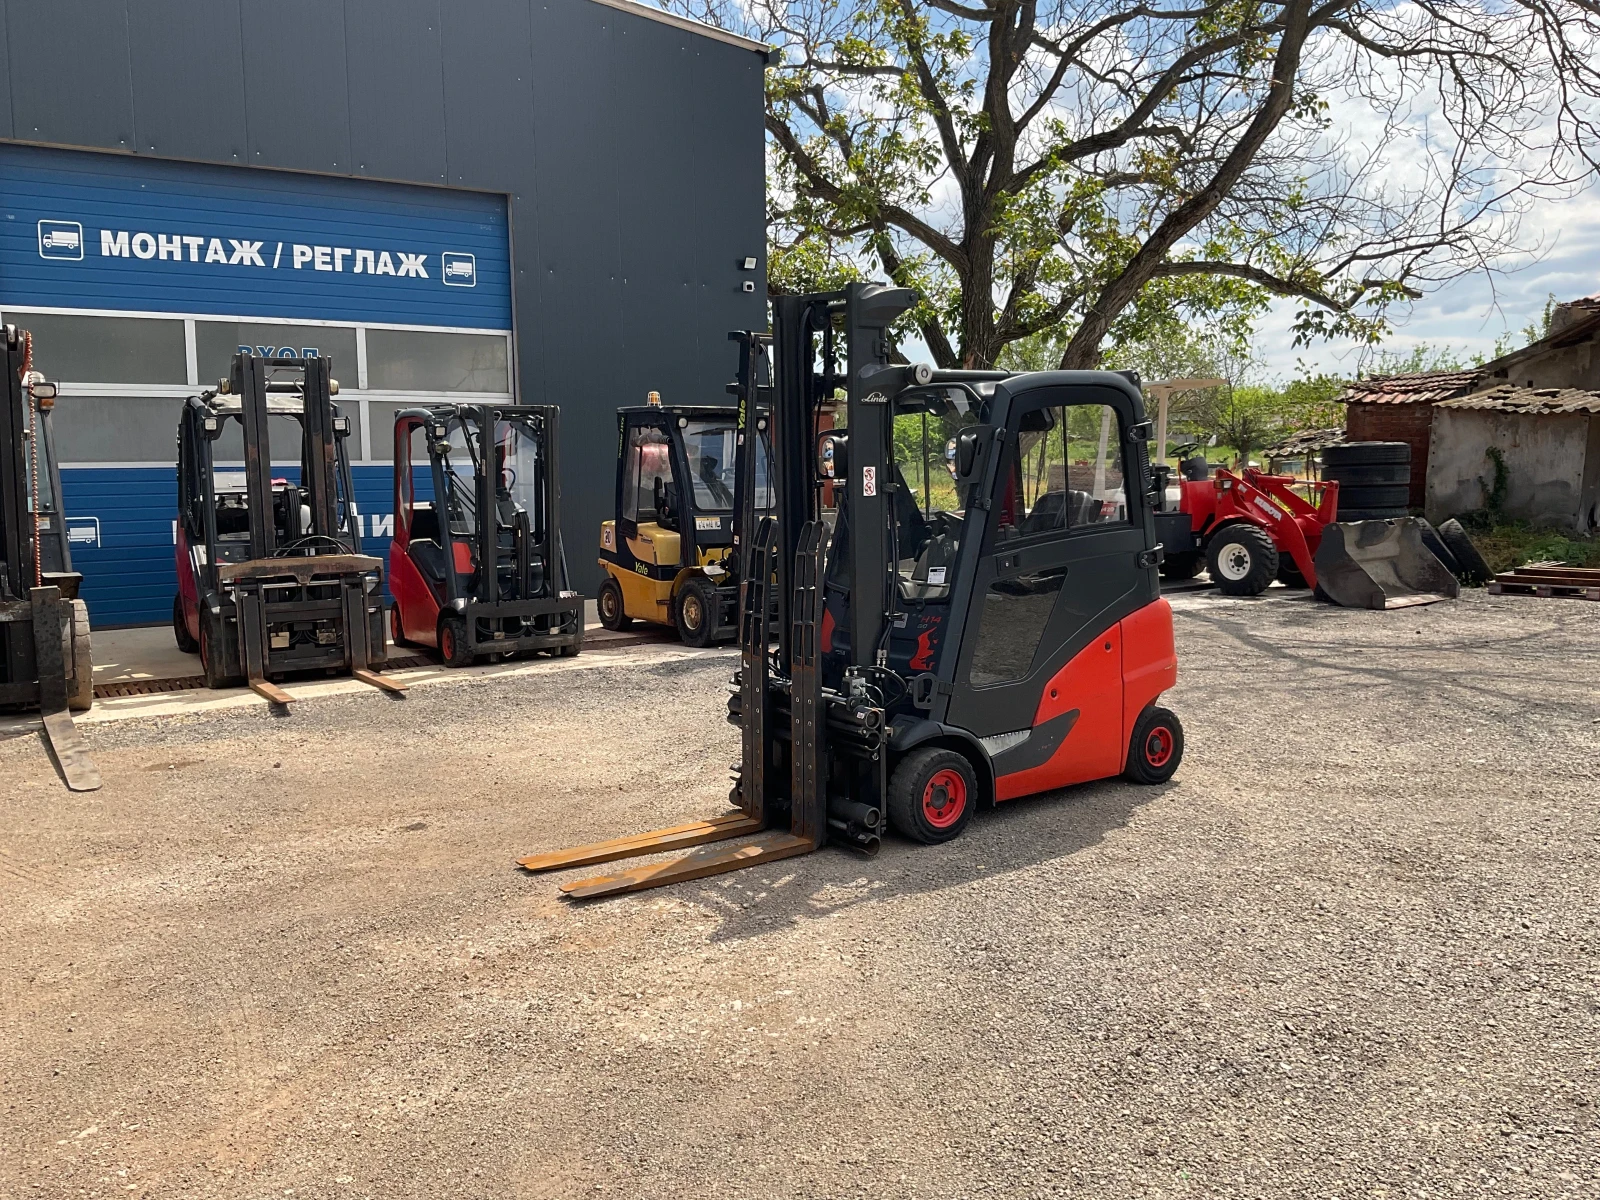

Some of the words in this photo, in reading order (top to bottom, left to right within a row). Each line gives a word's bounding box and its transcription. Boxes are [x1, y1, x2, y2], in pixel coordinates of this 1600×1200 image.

[100, 229, 266, 267] МОНТАЖ
[292, 244, 430, 279] РЕГЛАЖ
[861, 391, 888, 403] Linde
[738, 399, 746, 430] Yale
[635, 561, 649, 576] Yale
